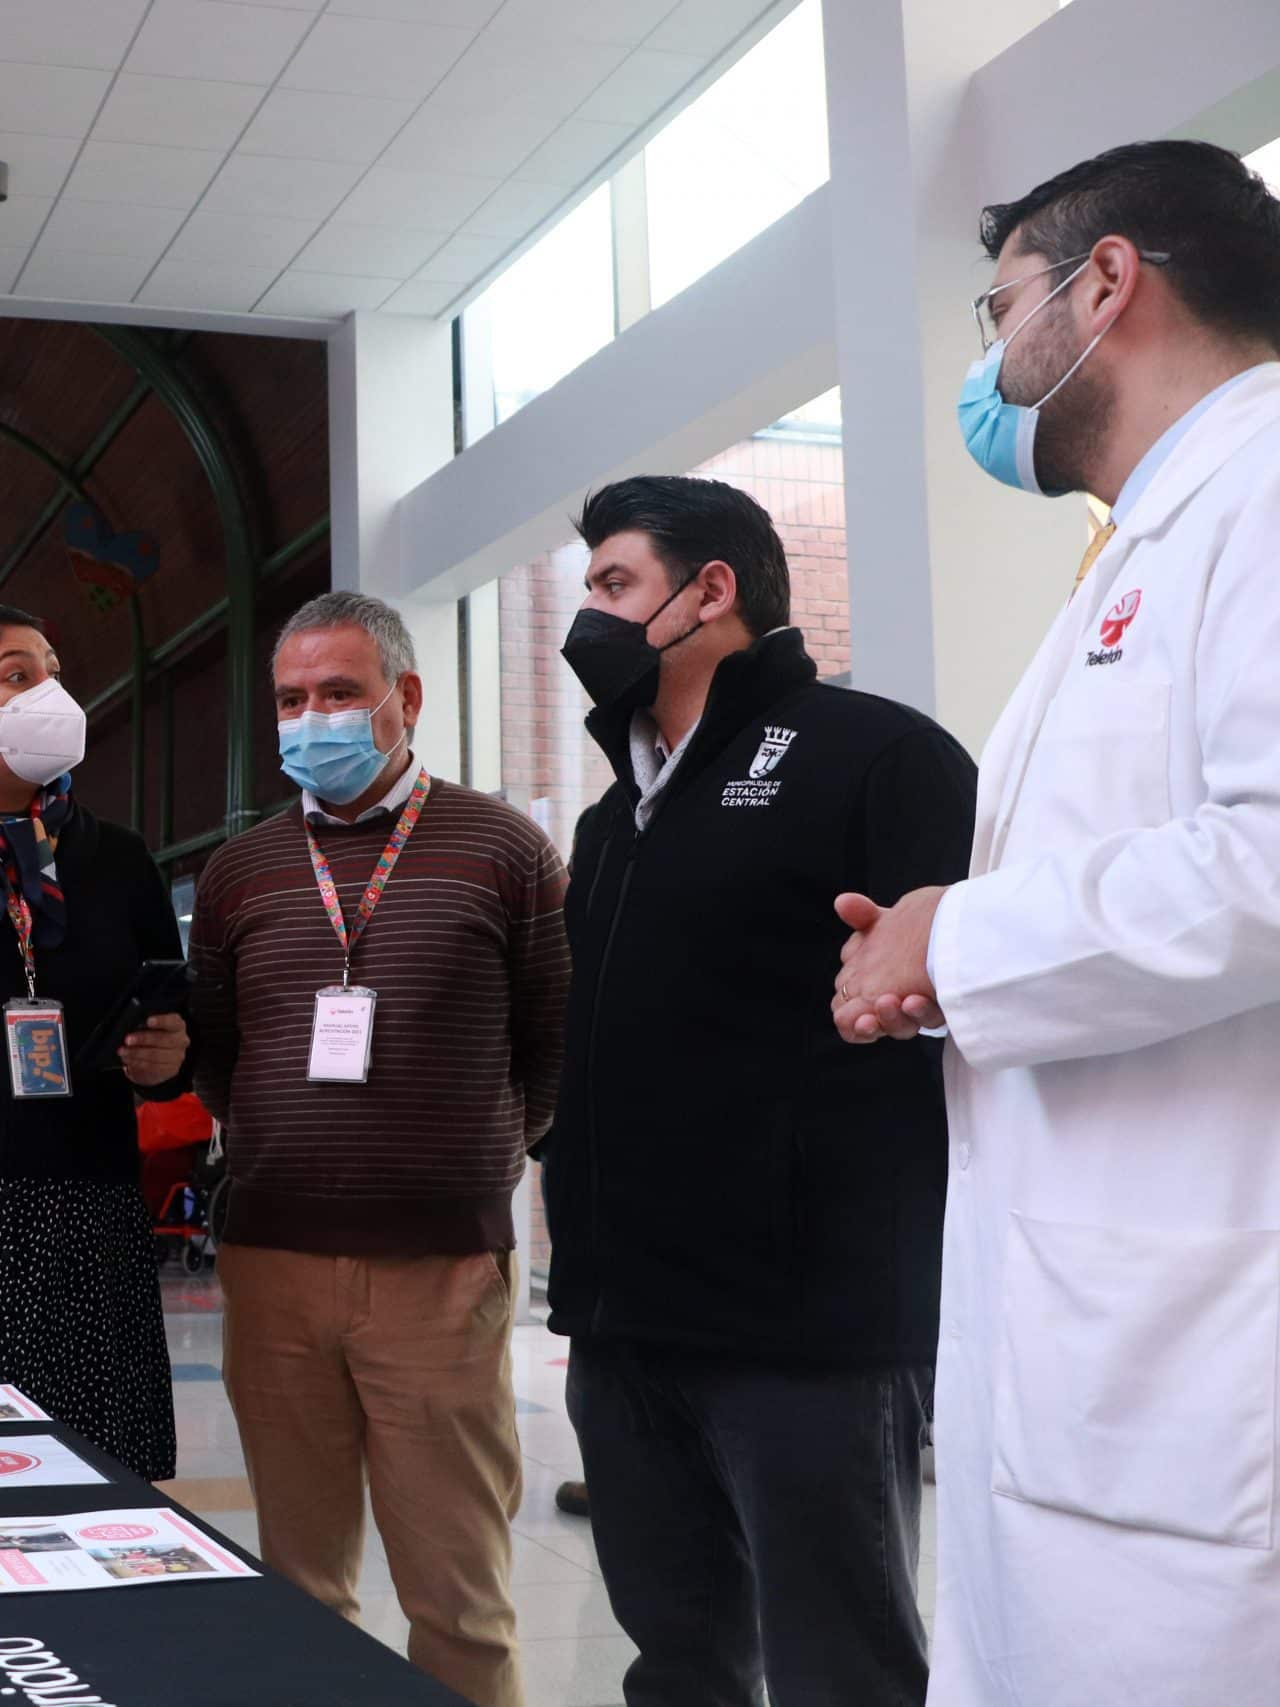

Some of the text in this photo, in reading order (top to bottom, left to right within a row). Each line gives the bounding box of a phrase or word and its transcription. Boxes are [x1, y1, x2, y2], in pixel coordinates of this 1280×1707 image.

[722, 787, 779, 797] ESTACIÓN
[721, 797, 770, 806] CENTRAL
[27, 1029, 64, 1084] bip!
